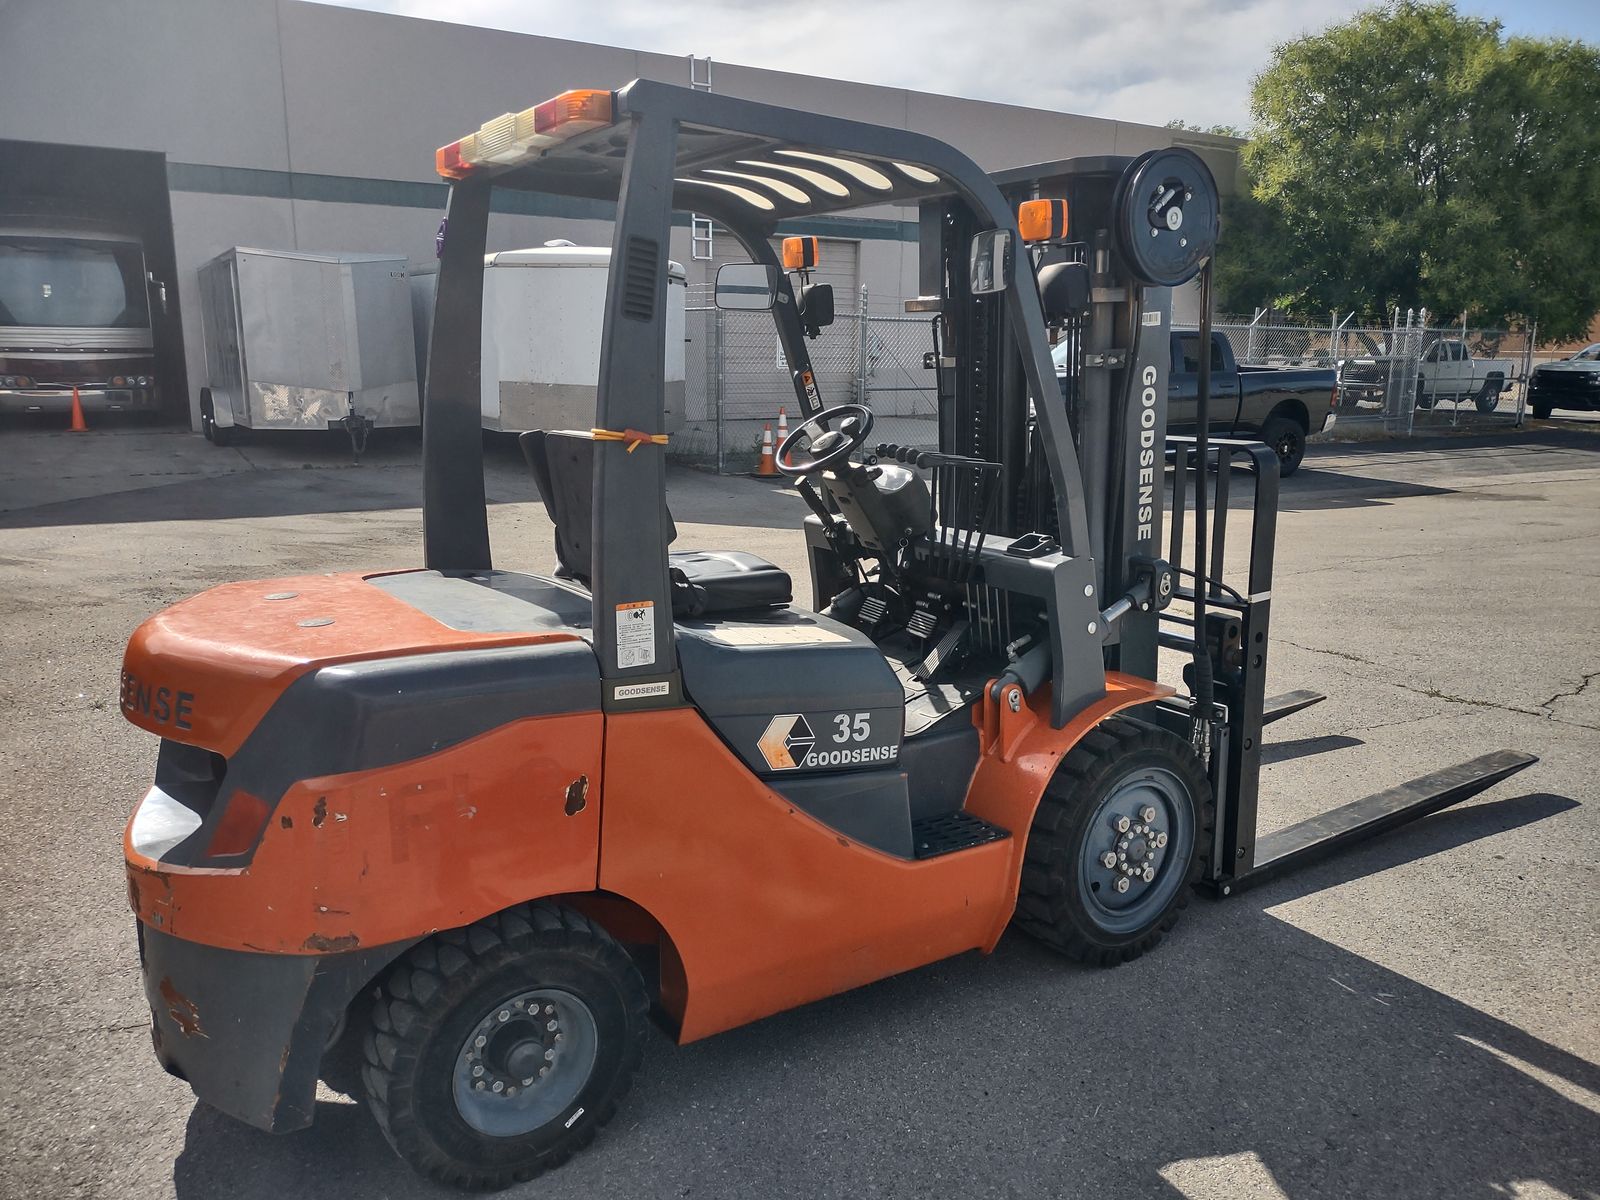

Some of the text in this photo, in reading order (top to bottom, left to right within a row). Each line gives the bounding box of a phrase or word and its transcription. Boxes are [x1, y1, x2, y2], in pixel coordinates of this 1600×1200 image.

[1137, 365, 1157, 541] GOODSENSE
[618, 685, 666, 697] GOODSENSE
[832, 712, 871, 743] 35
[807, 745, 899, 767] GOODSENSE
